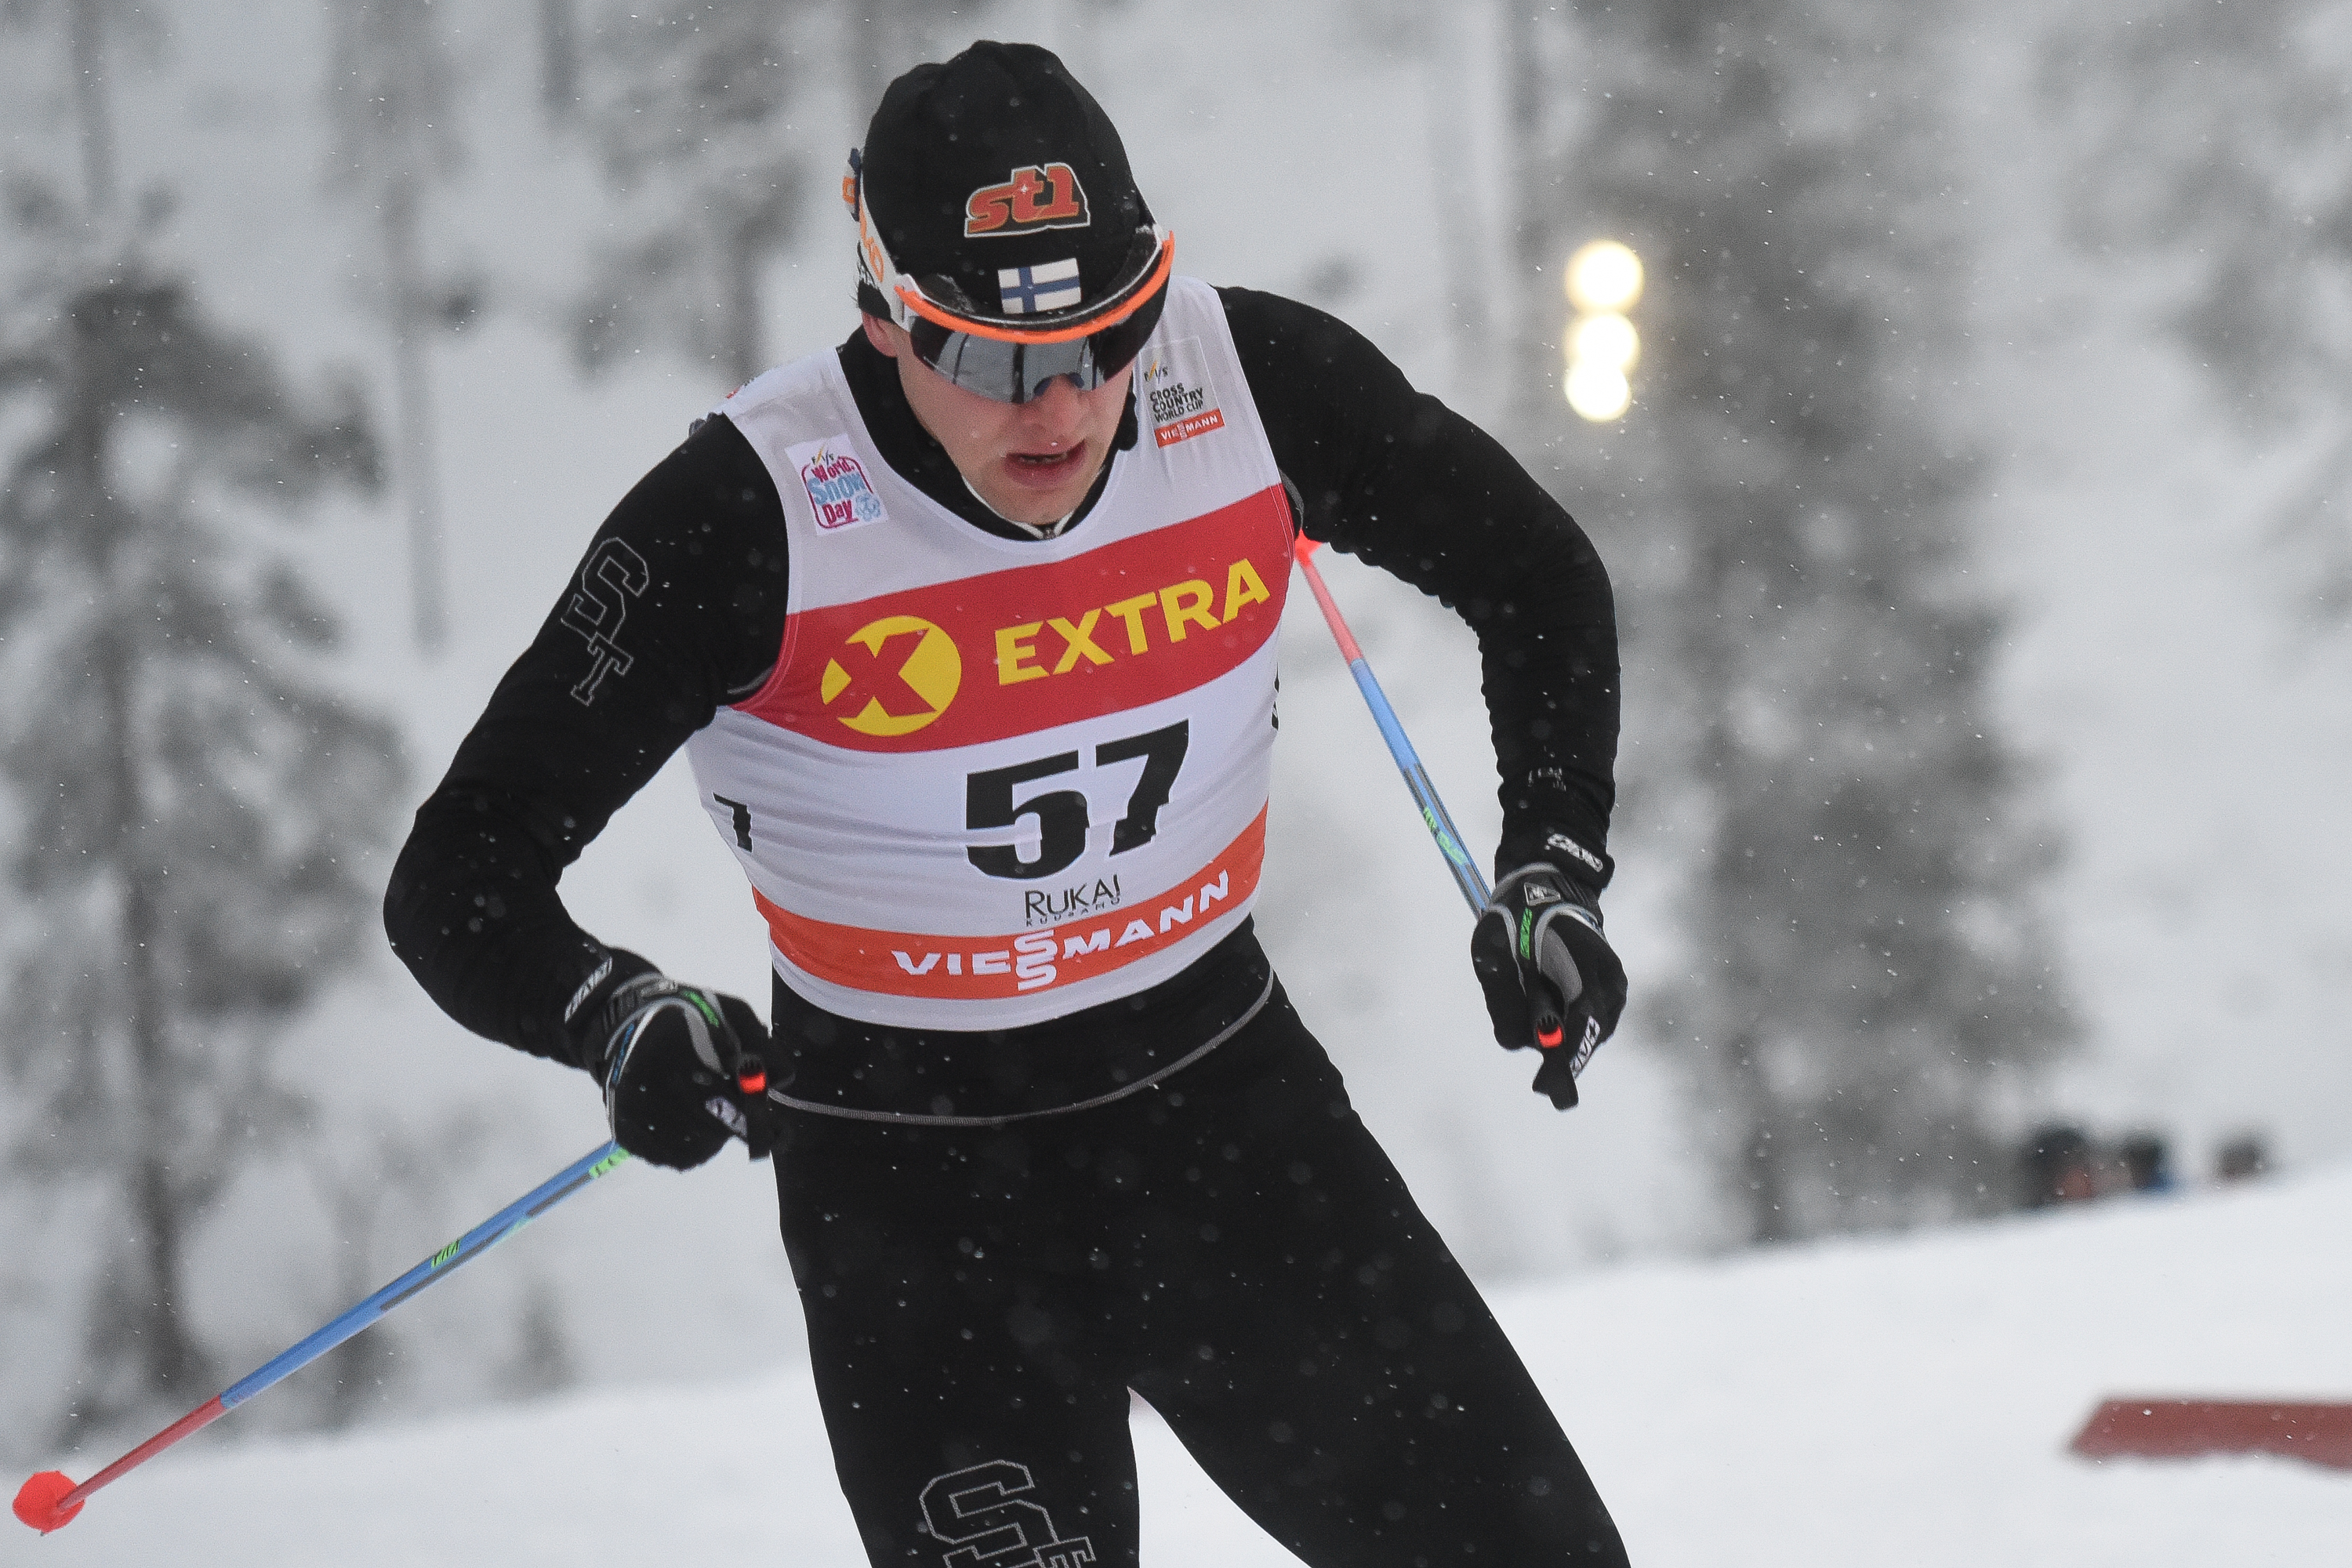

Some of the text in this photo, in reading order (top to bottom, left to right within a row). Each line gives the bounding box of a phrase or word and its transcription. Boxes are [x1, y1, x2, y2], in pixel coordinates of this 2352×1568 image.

[966, 163, 1081, 234] st1
[1149, 383, 1185, 402] CROSS
[1152, 387, 1203, 413] COUNTRY
[1155, 400, 1203, 423] WORLD CUP
[811, 456, 852, 483] World
[808, 474, 866, 506] Snow
[822, 499, 853, 524] Day
[994, 557, 1270, 686] EXTRA
[966, 718, 1189, 880] 57
[891, 869, 1229, 992] VIESSMANN
